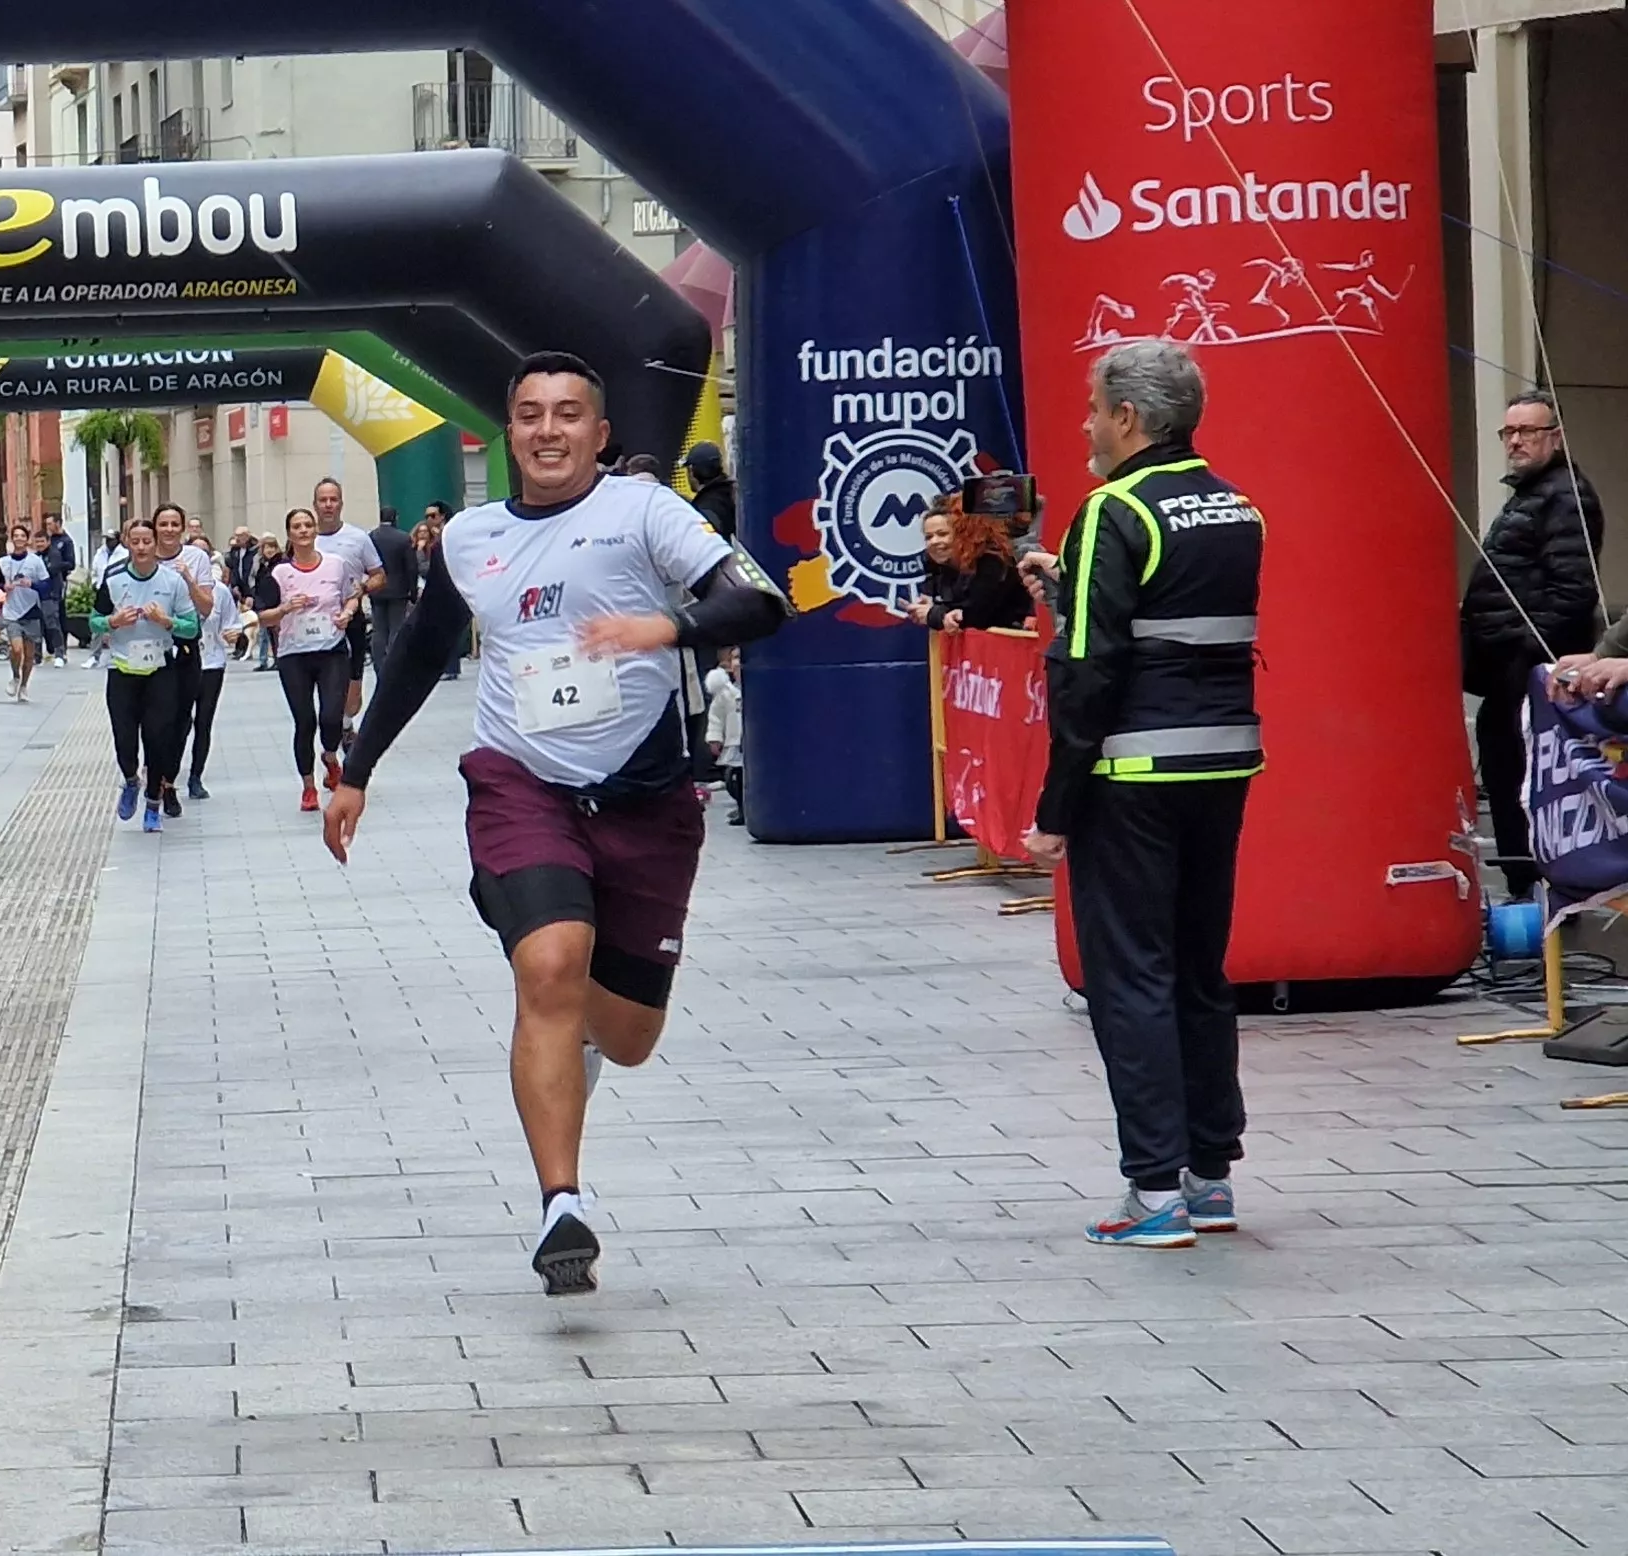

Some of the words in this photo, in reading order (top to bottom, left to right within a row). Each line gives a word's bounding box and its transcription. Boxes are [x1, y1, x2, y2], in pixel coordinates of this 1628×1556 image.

[1143, 72, 1334, 142] Sports
[1130, 169, 1412, 232] Santander
[16, 285, 29, 303] A
[34, 285, 56, 302] LA
[61, 281, 178, 301] OPERADORA
[181, 278, 297, 298] ARAGONESA
[798, 336, 1003, 382] fundación
[0, 380, 58, 397] CAJA
[66, 375, 141, 394] RURAL
[149, 374, 178, 391] DE
[186, 368, 283, 389] ARAGÓN
[833, 379, 965, 429] mupol
[870, 555, 924, 575] POLICI
[551, 686, 581, 706] 42
